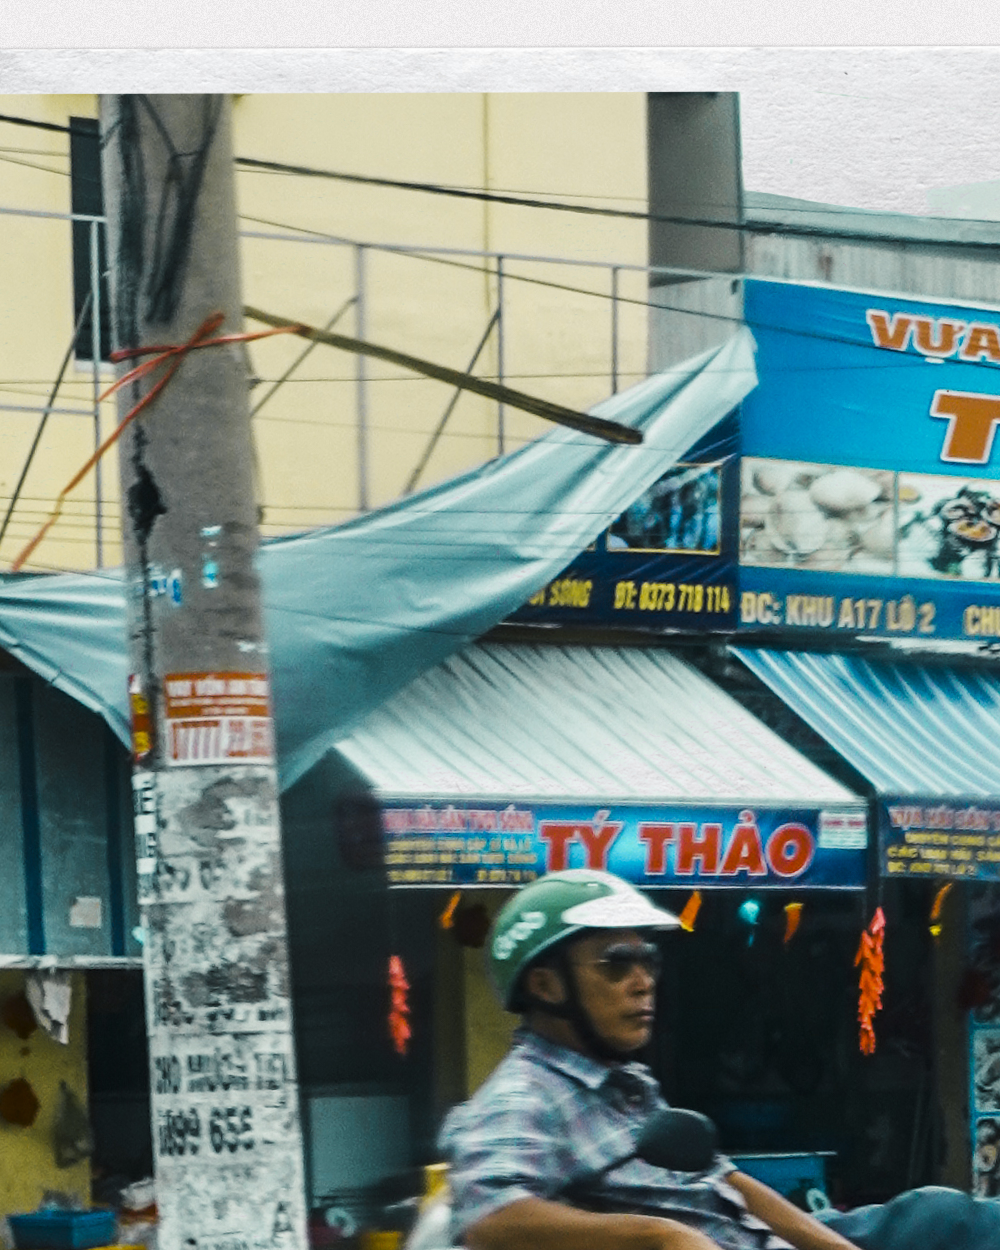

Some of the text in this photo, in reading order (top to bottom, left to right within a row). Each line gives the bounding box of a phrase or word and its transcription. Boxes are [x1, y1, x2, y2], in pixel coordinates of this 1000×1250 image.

[786, 594, 834, 628] KHU
[837, 598, 883, 629] A17
[918, 601, 936, 634] 2
[538, 809, 623, 872] TÝ
[638, 810, 816, 877] THẢO
